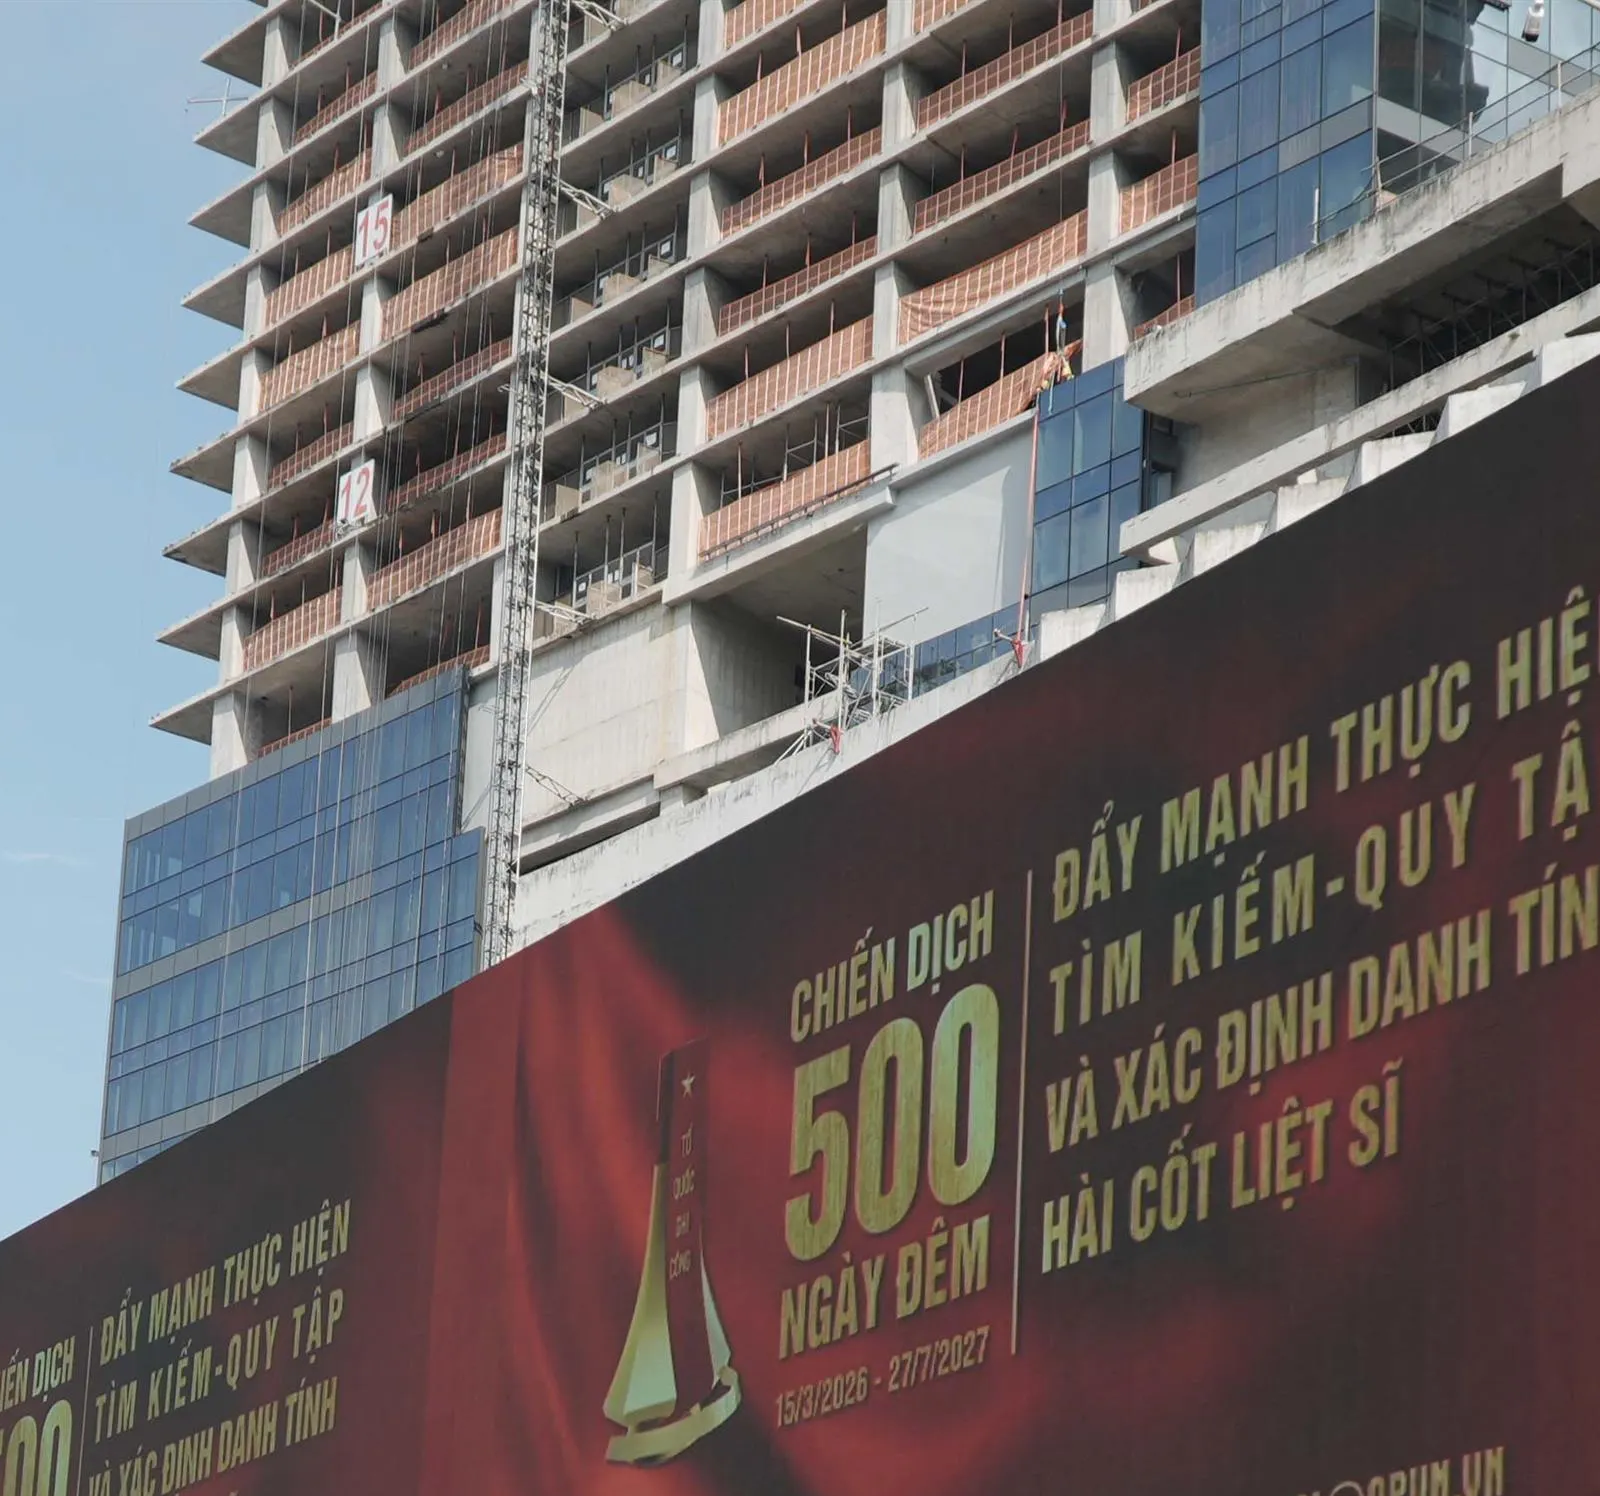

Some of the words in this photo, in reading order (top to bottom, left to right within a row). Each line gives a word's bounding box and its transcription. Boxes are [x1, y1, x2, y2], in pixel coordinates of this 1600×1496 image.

[358, 199, 389, 258] 15
[341, 466, 370, 520] 12
[1051, 801, 1137, 924] ĐẨY
[1160, 732, 1309, 874] MẠNH
[1328, 657, 1470, 794] THỰC
[791, 912, 896, 1043] CHIẾN
[905, 888, 995, 997] DỊCH
[1044, 1054, 1098, 1153] VÀ
[1113, 1017, 1201, 1127] XÁC
[1215, 971, 1333, 1097] ĐỊNH
[1346, 905, 1491, 1037] DANH
[1049, 927, 1143, 1037] TÌM
[783, 981, 998, 1262] 500
[1040, 1176, 1114, 1275] HÀI
[1127, 1120, 1218, 1243] CỐT
[1230, 1097, 1333, 1209] LIỆT
[1347, 1057, 1403, 1168] SĨ
[100, 1287, 143, 1367] ĐẨY
[148, 1265, 216, 1345] MẠNH
[223, 1232, 282, 1307] THỰC
[289, 1197, 351, 1276] HIỆN
[777, 1250, 884, 1361] NGÀY
[895, 1216, 991, 1320] ĐÊM
[31, 1335, 76, 1401] DỊCH
[95, 1375, 137, 1445] TÌM
[292, 1286, 345, 1365] TẬP
[217, 1400, 279, 1471] DANH
[285, 1376, 338, 1448] TÍNH
[774, 1363, 869, 1428] 15/3/2026
[888, 1325, 991, 1396] 27/7/2027
